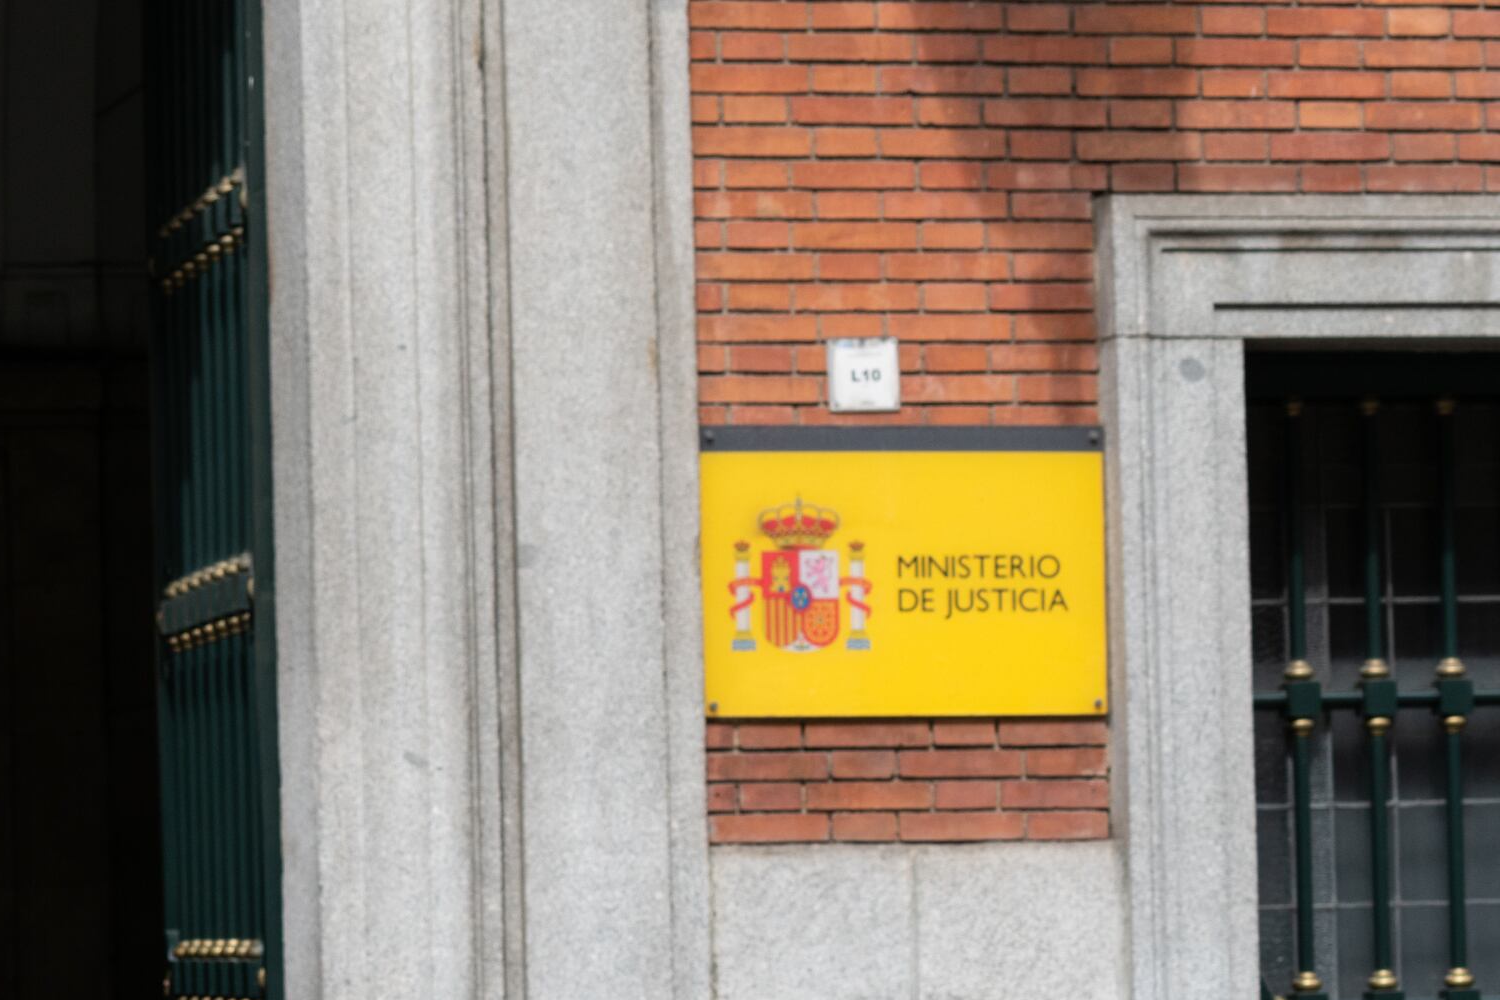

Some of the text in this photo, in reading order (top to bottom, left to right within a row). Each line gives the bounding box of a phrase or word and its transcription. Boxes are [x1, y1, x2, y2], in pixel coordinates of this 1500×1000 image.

[897, 555, 1061, 579] MINISTERIO
[897, 588, 1069, 620] DE JUSTICIA
